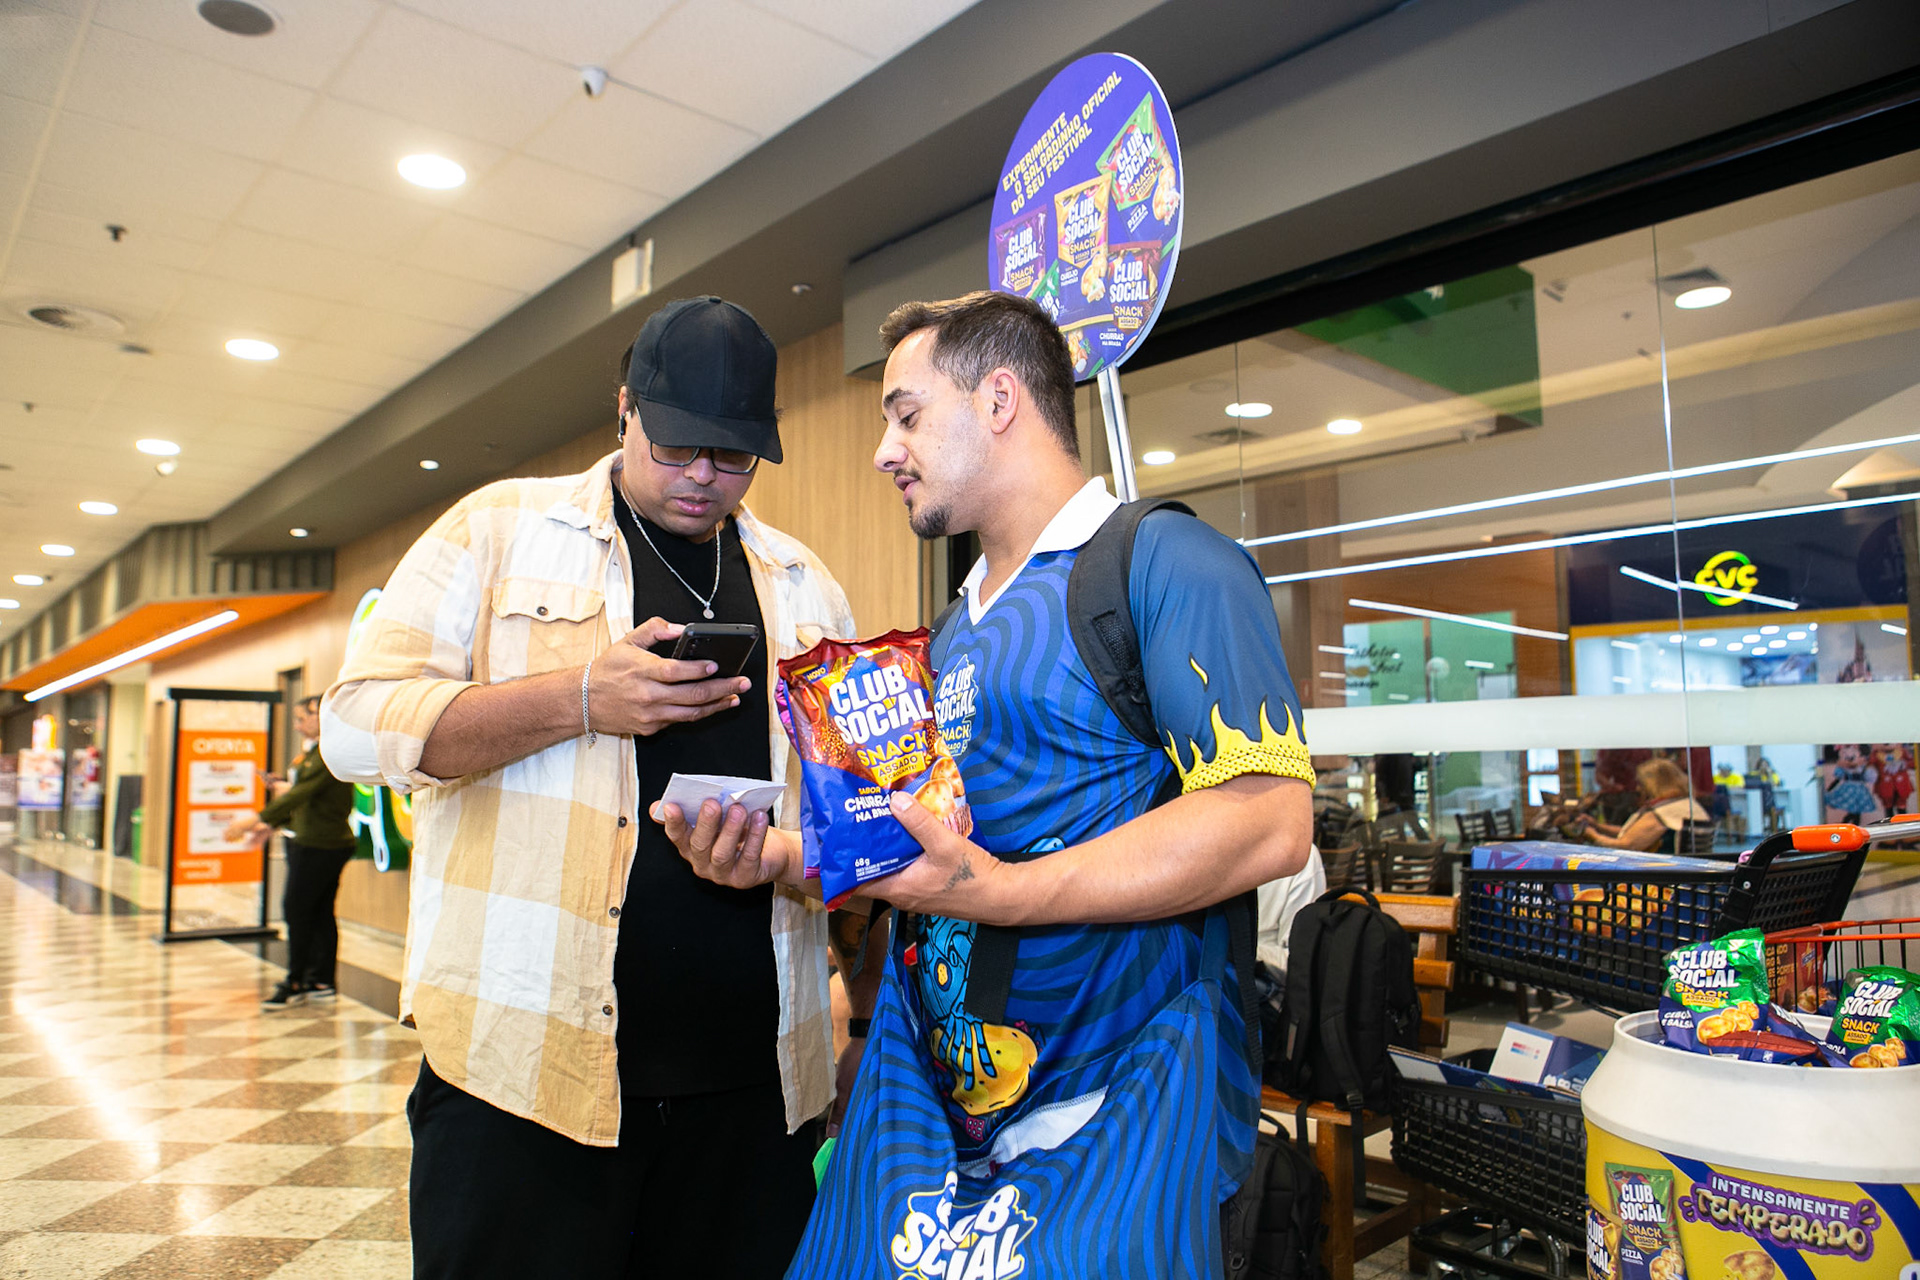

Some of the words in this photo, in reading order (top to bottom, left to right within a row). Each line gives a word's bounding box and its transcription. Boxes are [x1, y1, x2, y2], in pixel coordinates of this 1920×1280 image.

[1014, 180, 1022, 195] O
[1023, 114, 1081, 186] SALGADINHO
[1082, 71, 1122, 120] OFICIAL
[1002, 112, 1067, 191] EXPERIMENTE
[1117, 127, 1144, 172] CLUB
[1011, 194, 1025, 215] DO
[1026, 171, 1045, 199] SEU
[1046, 122, 1092, 178] FESTIVAL
[1129, 160, 1156, 196] SNACK
[1068, 197, 1095, 224] CLUB
[1127, 204, 1147, 229] PIZZA
[1009, 227, 1033, 254] CLUB
[1070, 237, 1096, 255] SNACK
[1011, 265, 1034, 281] SNACK
[1114, 261, 1143, 283] CLUB
[1114, 305, 1143, 316] SNACK
[807, 667, 826, 681] NOVO
[940, 664, 975, 699] CLUB
[829, 665, 907, 714] CLUB
[857, 731, 928, 766] SNACK
[878, 755, 917, 777] ASSADO
[855, 811, 872, 822] NA
[1677, 950, 1727, 969] CLUB
[1675, 982, 1729, 999] SNACK
[1854, 981, 1904, 1000] CLUB
[1841, 1017, 1880, 1034] SNACK
[1621, 1183, 1654, 1203] CLUB
[1711, 1176, 1850, 1219] INTENSAMENTE
[1627, 1224, 1662, 1239] SNACK
[1695, 1187, 1867, 1255] TEMPERADO
[1621, 1248, 1643, 1260] PIZZA
